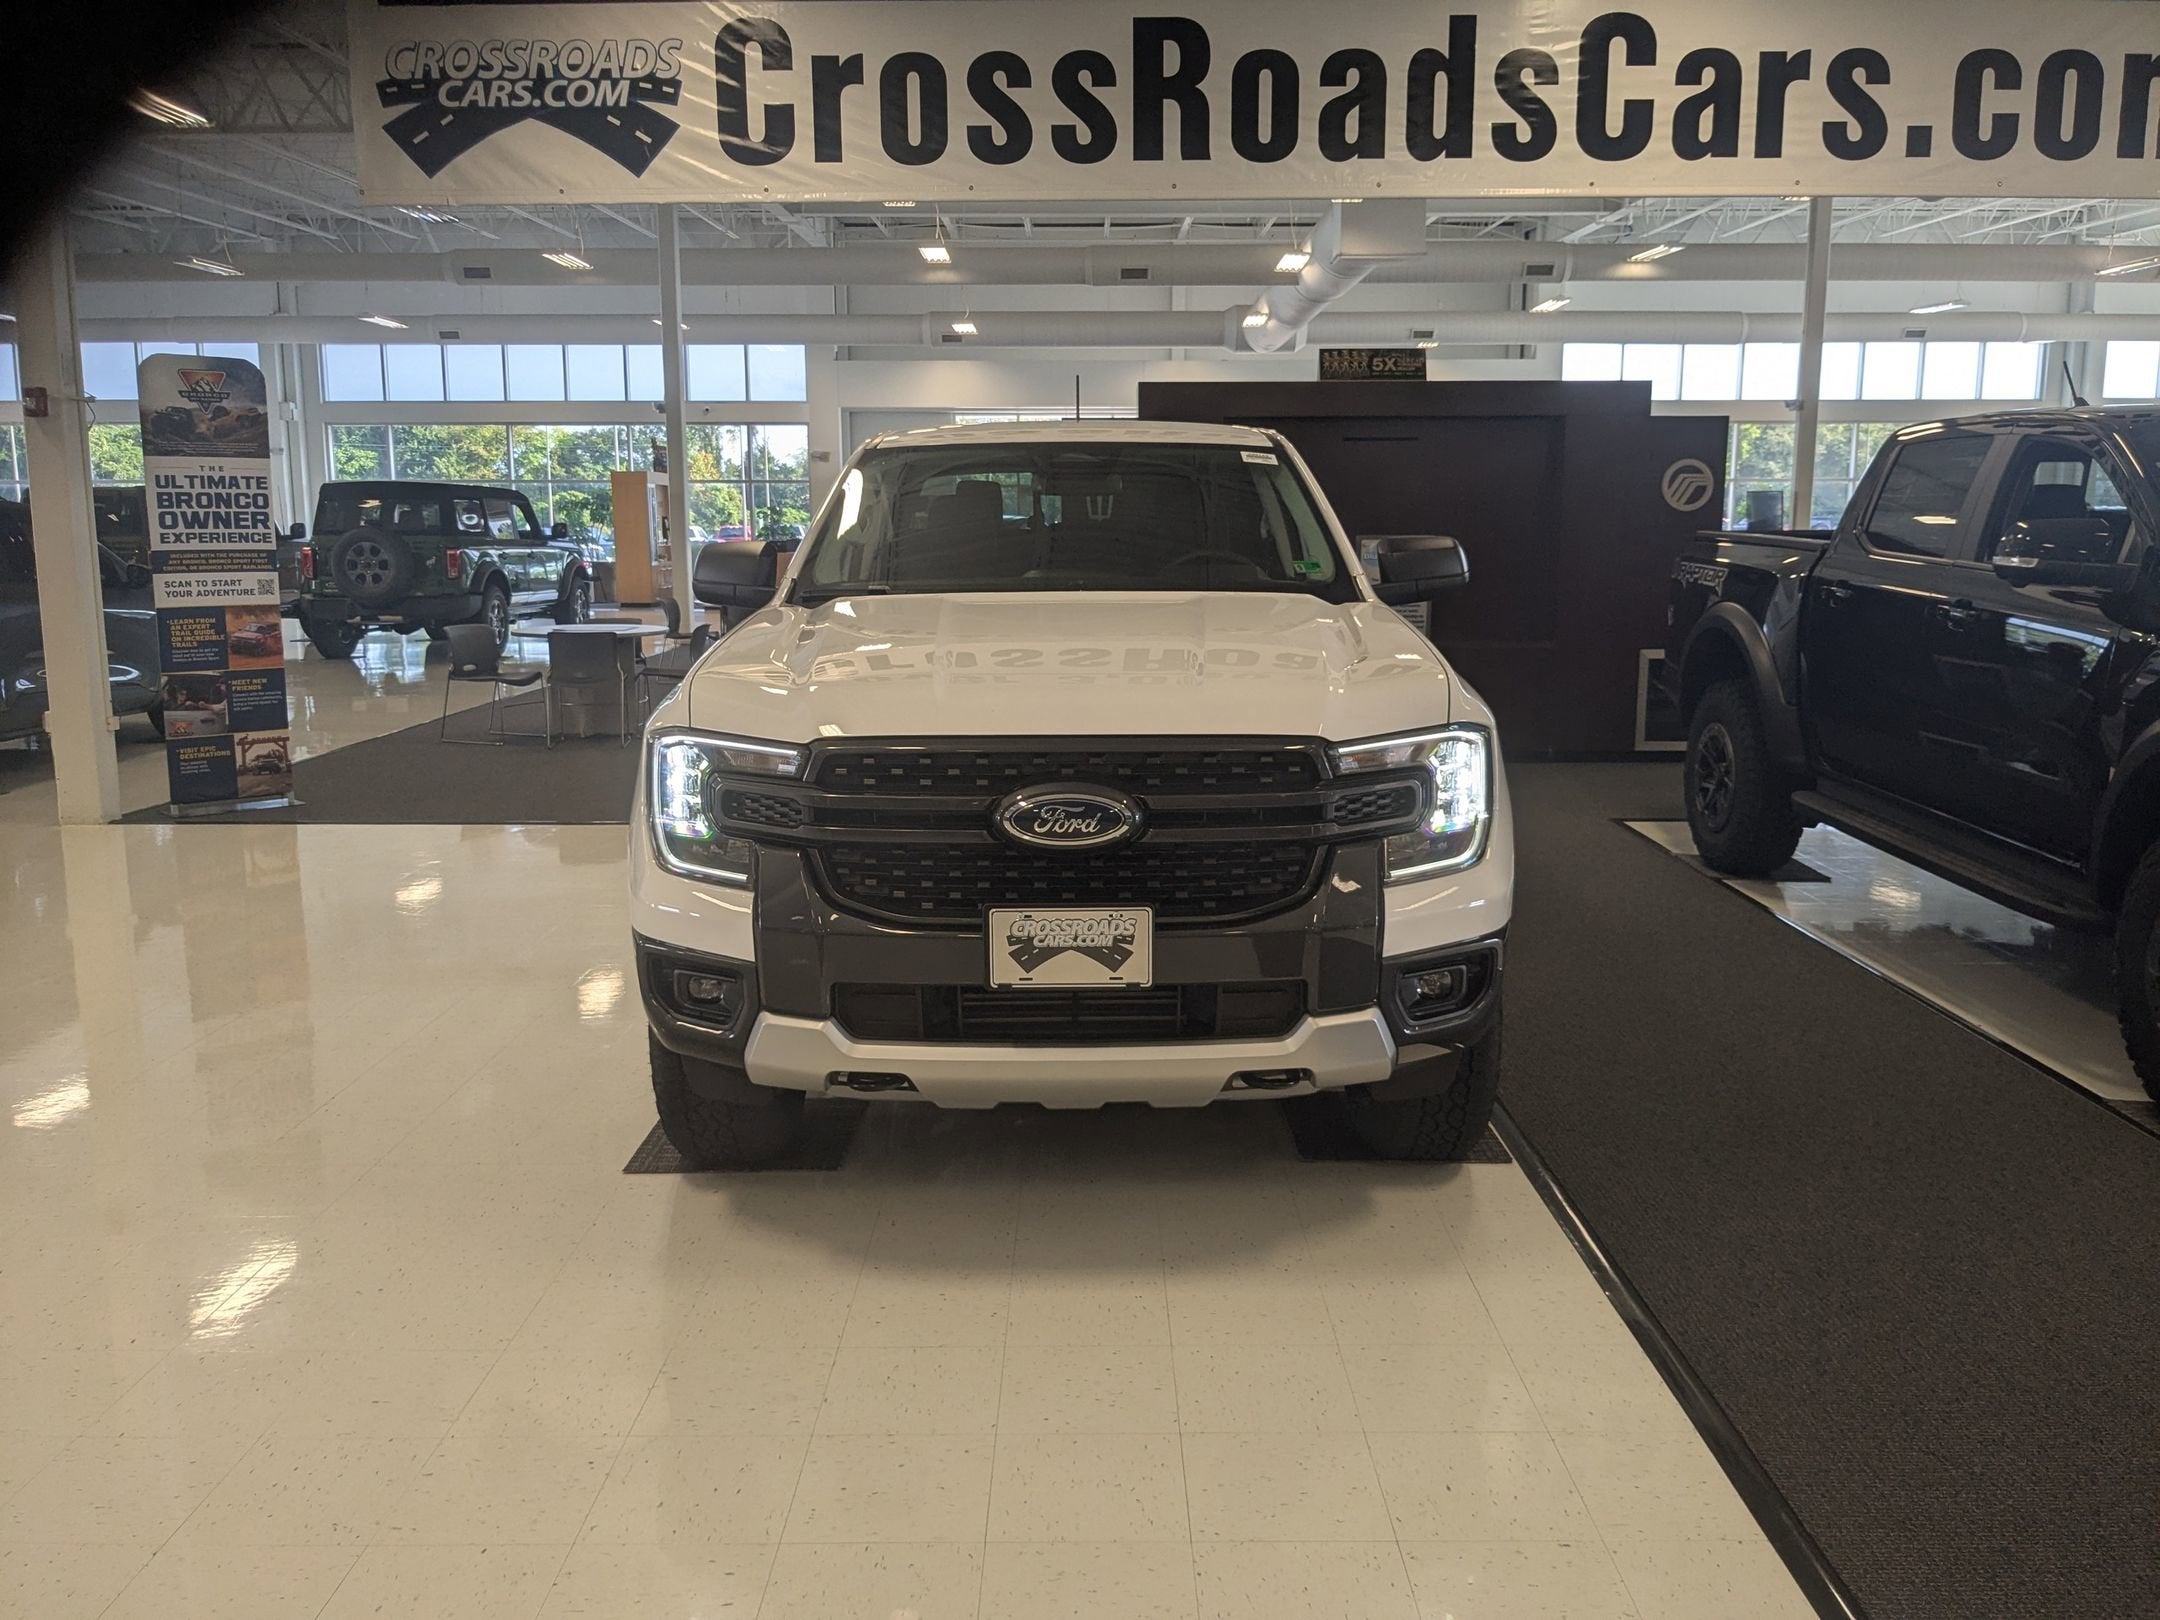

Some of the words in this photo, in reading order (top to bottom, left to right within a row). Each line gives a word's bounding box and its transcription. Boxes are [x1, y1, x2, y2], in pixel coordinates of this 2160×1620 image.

[385, 38, 684, 80] CROSSROADS
[437, 79, 632, 107] CARS.COM
[155, 474, 269, 490] ULTIMATE
[156, 491, 270, 510] BRONCO
[158, 510, 271, 530] OWNER
[160, 532, 273, 545] EXPERIENCE
[164, 580, 192, 588] SCAN
[211, 579, 243, 587] START
[1680, 561, 1728, 596] RAPTOR
[165, 590, 193, 598] YOUR
[196, 588, 256, 597] ADVENTURE
[1034, 805, 1101, 833] Ford
[1009, 918, 1137, 938] CROSSROADS
[1032, 934, 1115, 948] CARS.COM
